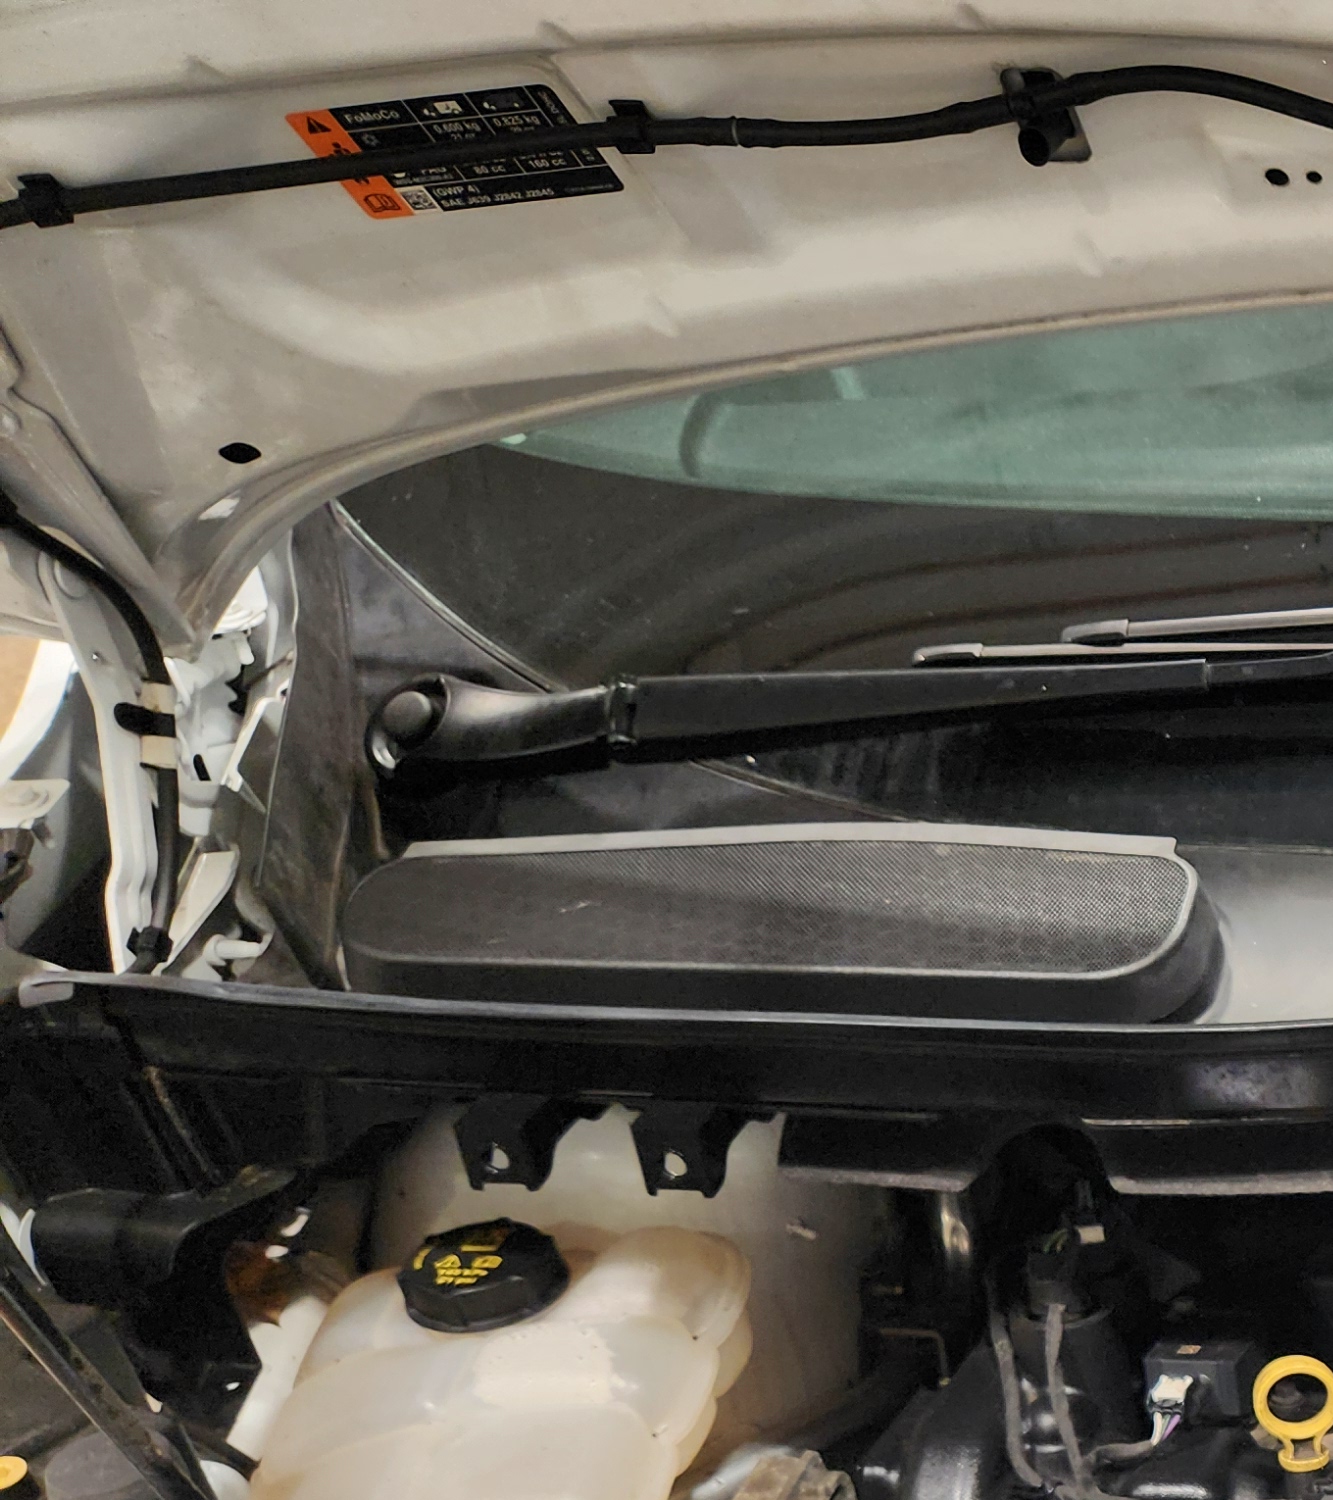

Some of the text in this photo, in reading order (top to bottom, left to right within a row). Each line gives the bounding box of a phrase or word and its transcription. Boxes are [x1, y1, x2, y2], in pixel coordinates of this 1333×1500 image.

[345, 109, 399, 123] FoMoCo
[525, 115, 540, 126] kg
[464, 121, 482, 132] kg
[433, 186, 465, 197] (GWP
[441, 198, 465, 208] SAE
